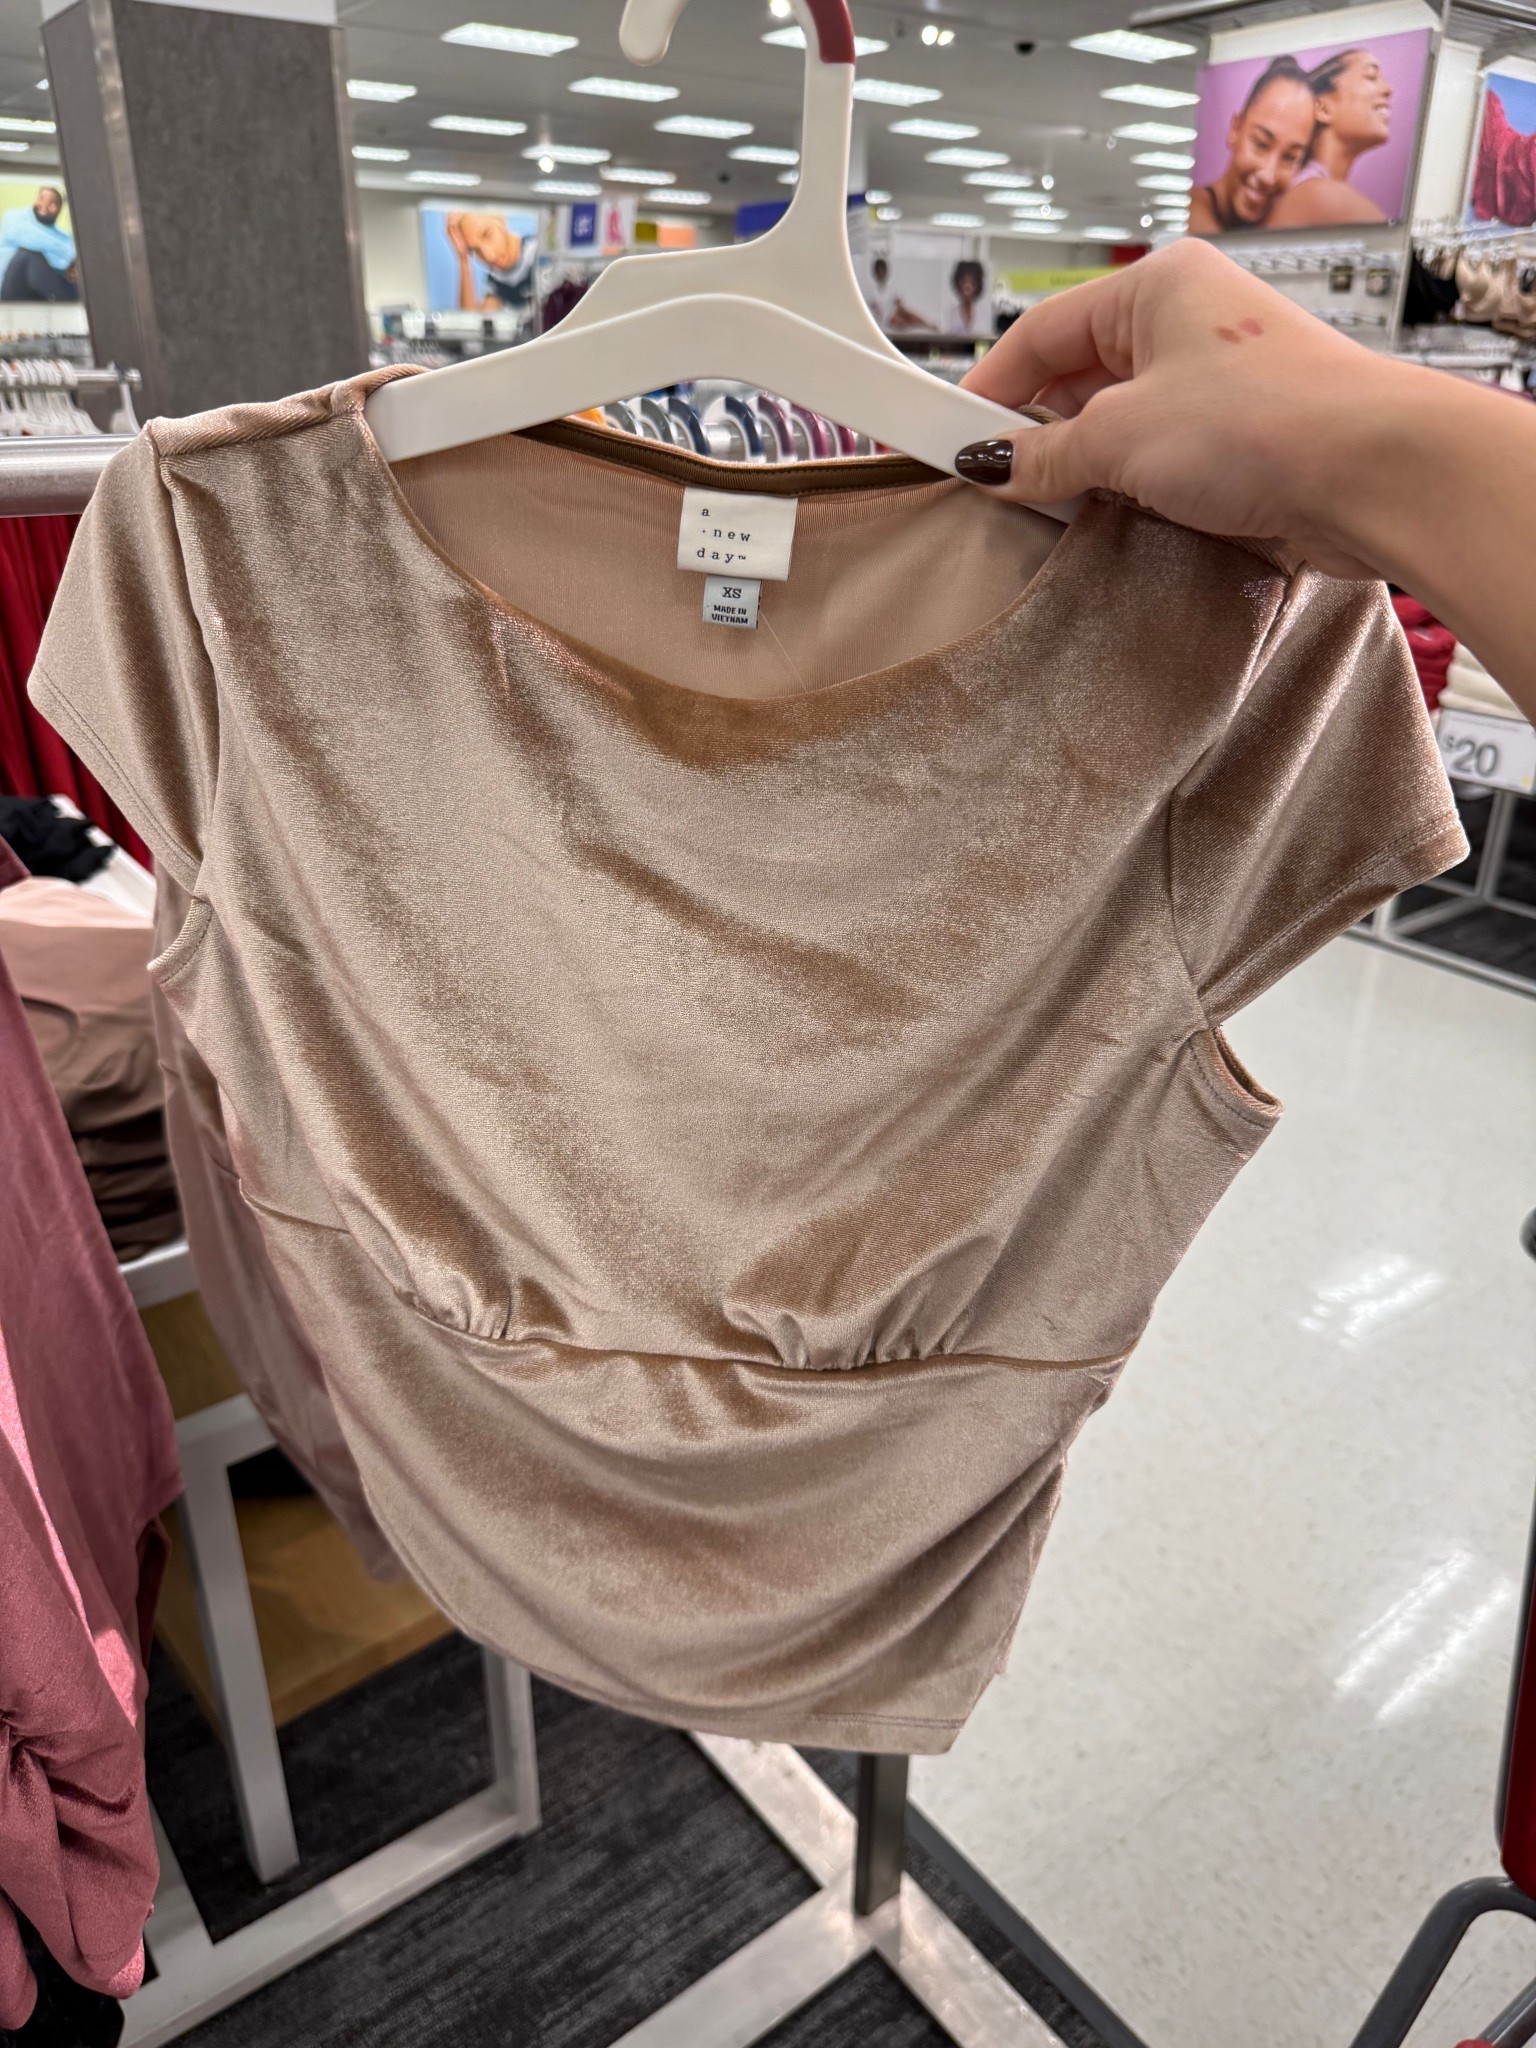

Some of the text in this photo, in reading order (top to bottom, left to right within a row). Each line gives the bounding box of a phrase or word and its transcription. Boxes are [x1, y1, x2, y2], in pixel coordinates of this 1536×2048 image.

[701, 508, 710, 517] a
[722, 586, 742, 599] XS
[713, 604, 747, 615] MADE IN
[711, 613, 749, 624] VIETNAM
